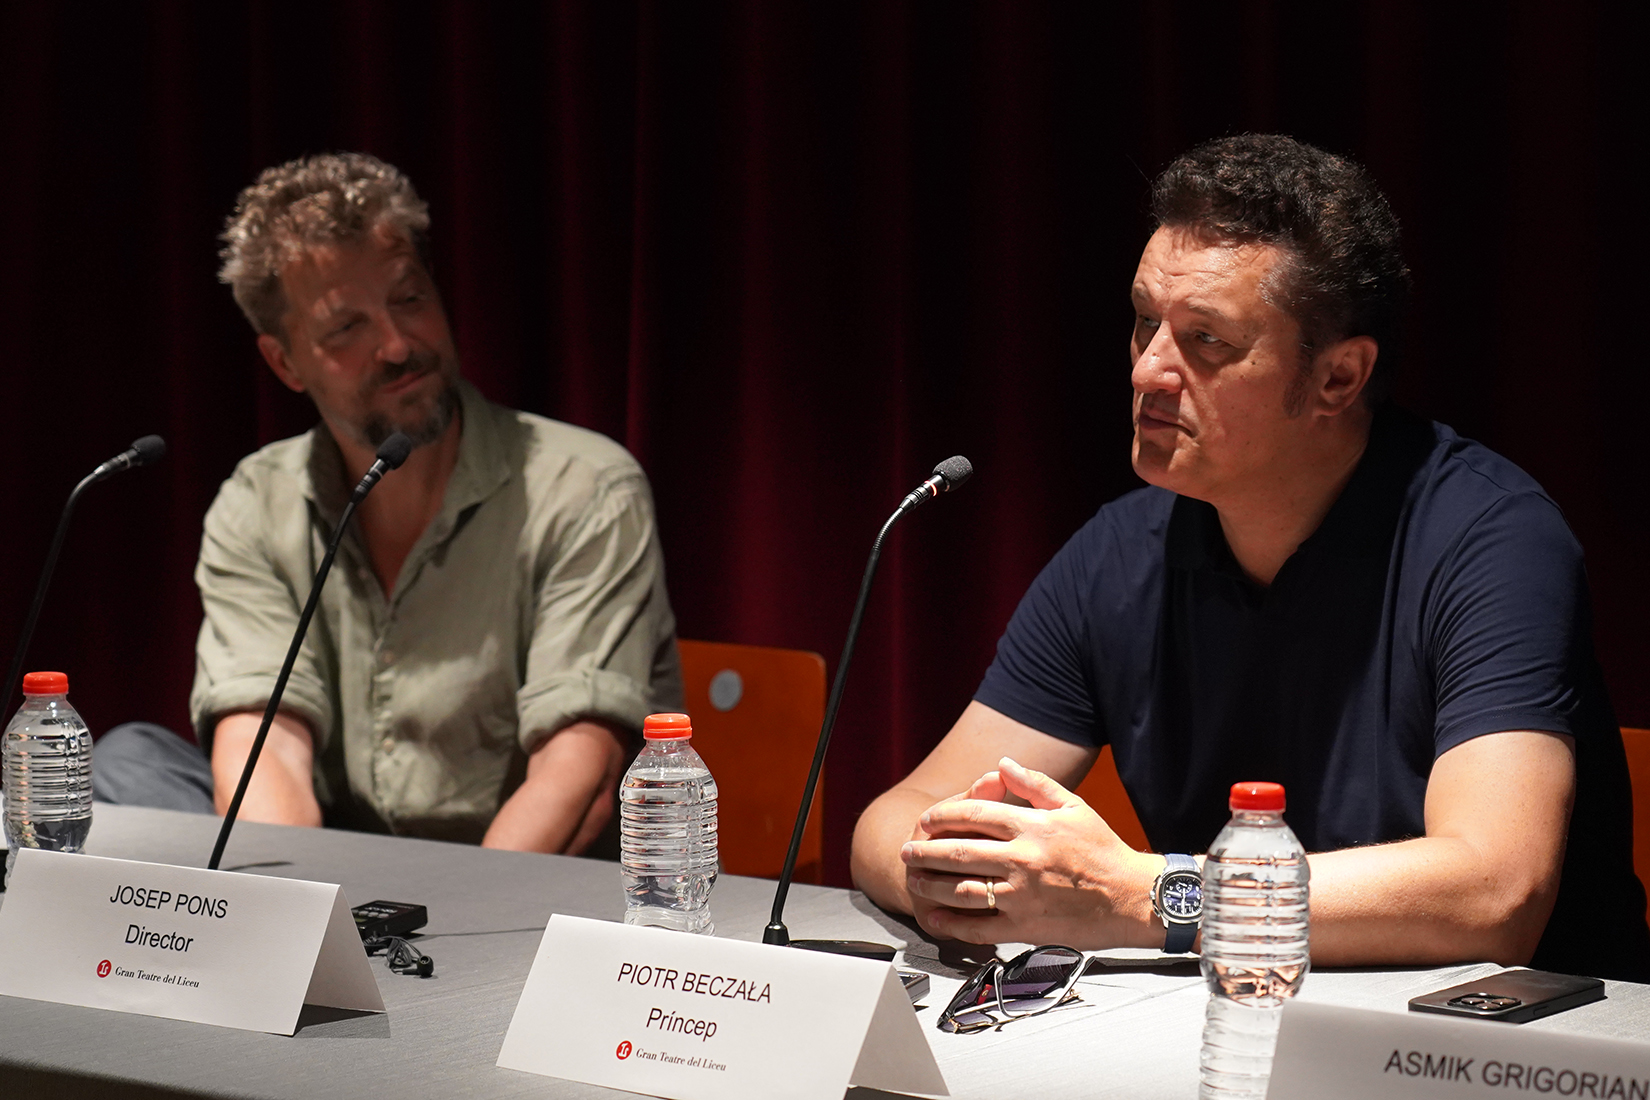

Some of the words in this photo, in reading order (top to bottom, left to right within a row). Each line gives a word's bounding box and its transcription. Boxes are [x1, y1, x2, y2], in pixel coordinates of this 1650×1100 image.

[109, 884, 172, 910] JOSEP
[174, 893, 229, 919] PONS
[125, 924, 194, 953] Director
[115, 966, 135, 978] Gran
[137, 969, 162, 983] Teatre
[162, 974, 176, 985] del
[177, 976, 200, 989] Liceu
[617, 962, 679, 990] PIOTR
[681, 971, 772, 1004] BECZAŁA
[645, 1007, 718, 1043] Príncep
[635, 1047, 658, 1061] Gran
[659, 1051, 686, 1066] Teatre
[686, 1056, 702, 1068] del
[702, 1058, 727, 1072] Liceu
[1384, 1049, 1476, 1084] ASMIK
[1480, 1060, 1650, 1100] GRIGORIAN
